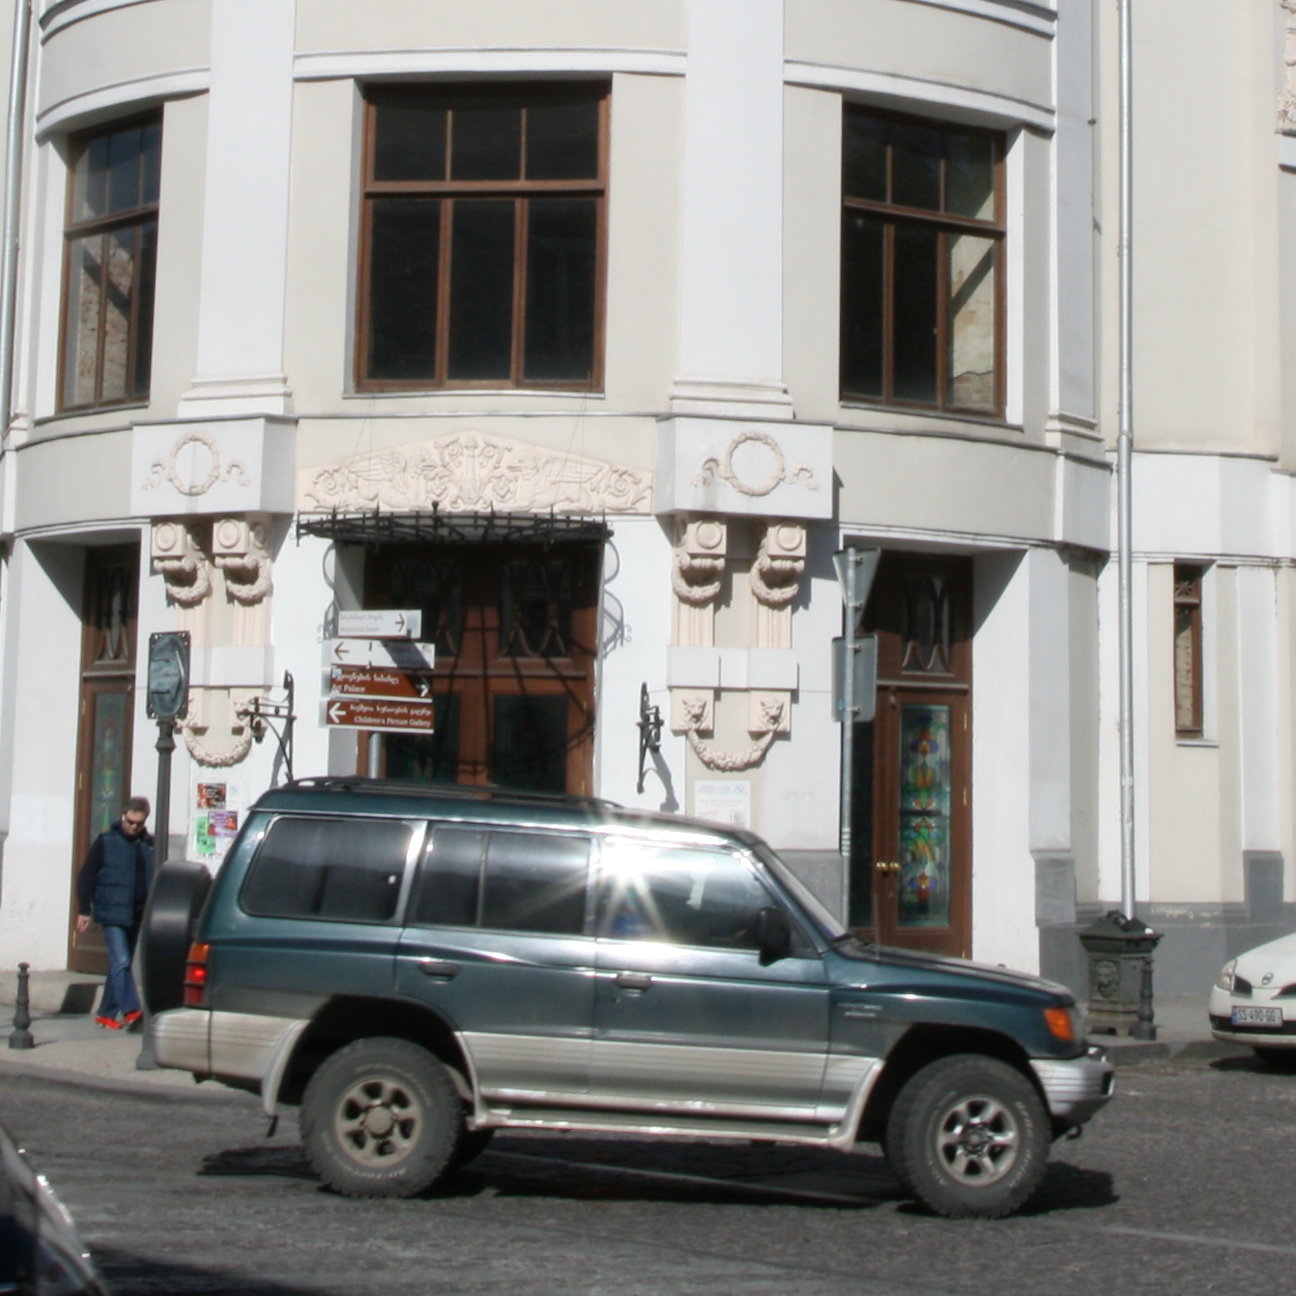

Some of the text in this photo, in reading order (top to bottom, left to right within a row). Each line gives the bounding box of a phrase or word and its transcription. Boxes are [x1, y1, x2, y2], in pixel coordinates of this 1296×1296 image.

[343, 684, 366, 693] Palace
[386, 717, 408, 726] Picture
[409, 719, 431, 729] Gallery
